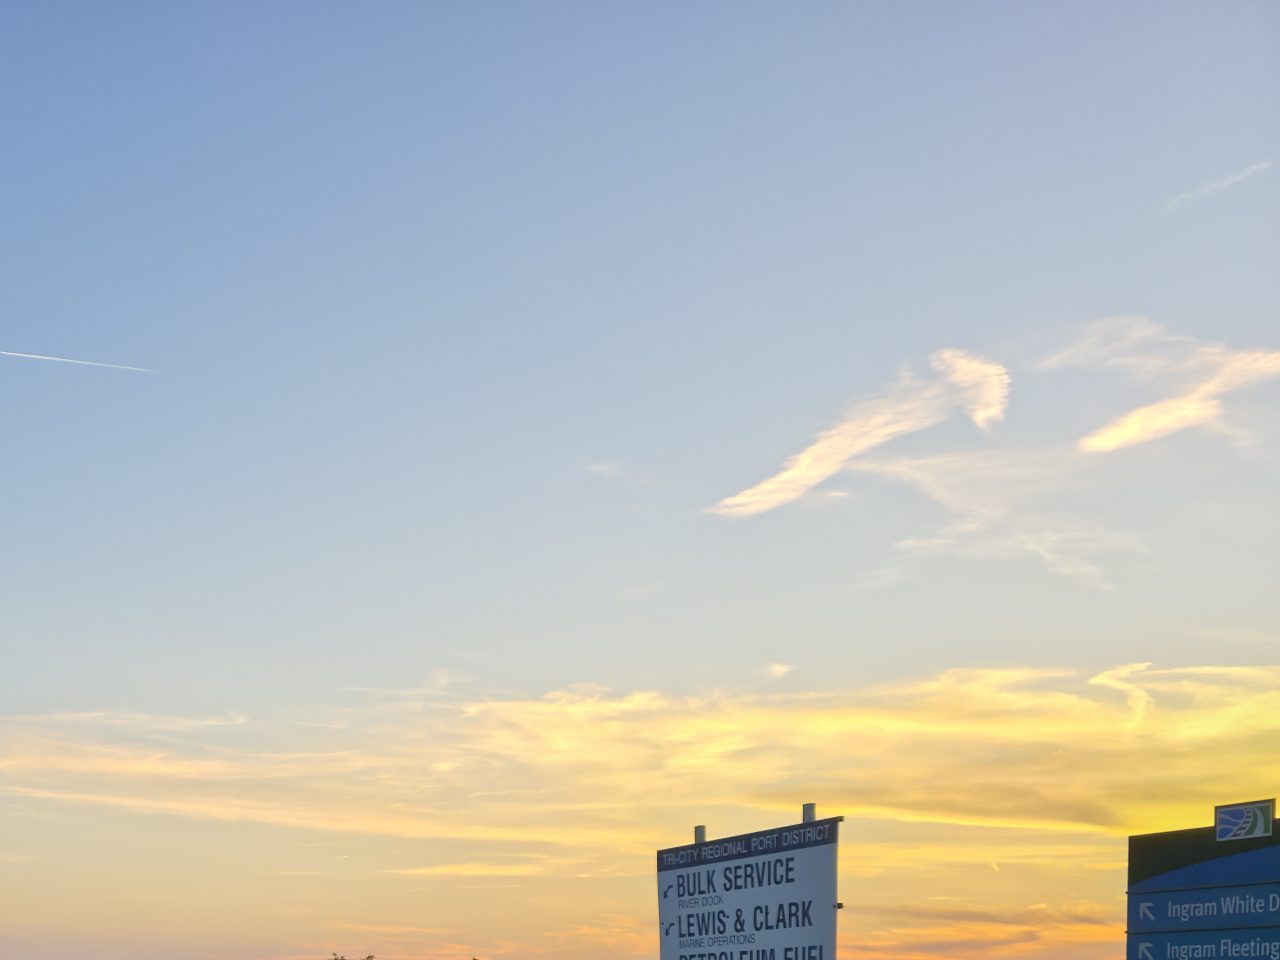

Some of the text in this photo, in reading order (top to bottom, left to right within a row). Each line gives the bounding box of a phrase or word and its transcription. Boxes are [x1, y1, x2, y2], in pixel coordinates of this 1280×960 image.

[663, 824, 831, 866] TRI-CITY REGIONAL PORT DISTRICT
[676, 857, 796, 897] BULK SERVICE
[678, 895, 724, 909] RIVER DOCK
[1167, 901, 1217, 921] Ingram
[1220, 894, 1265, 915] White
[678, 900, 813, 938] LEWIS & CLARK
[679, 934, 756, 949] MARINE OPERATIONS
[1220, 937, 1280, 960] Fleeting
